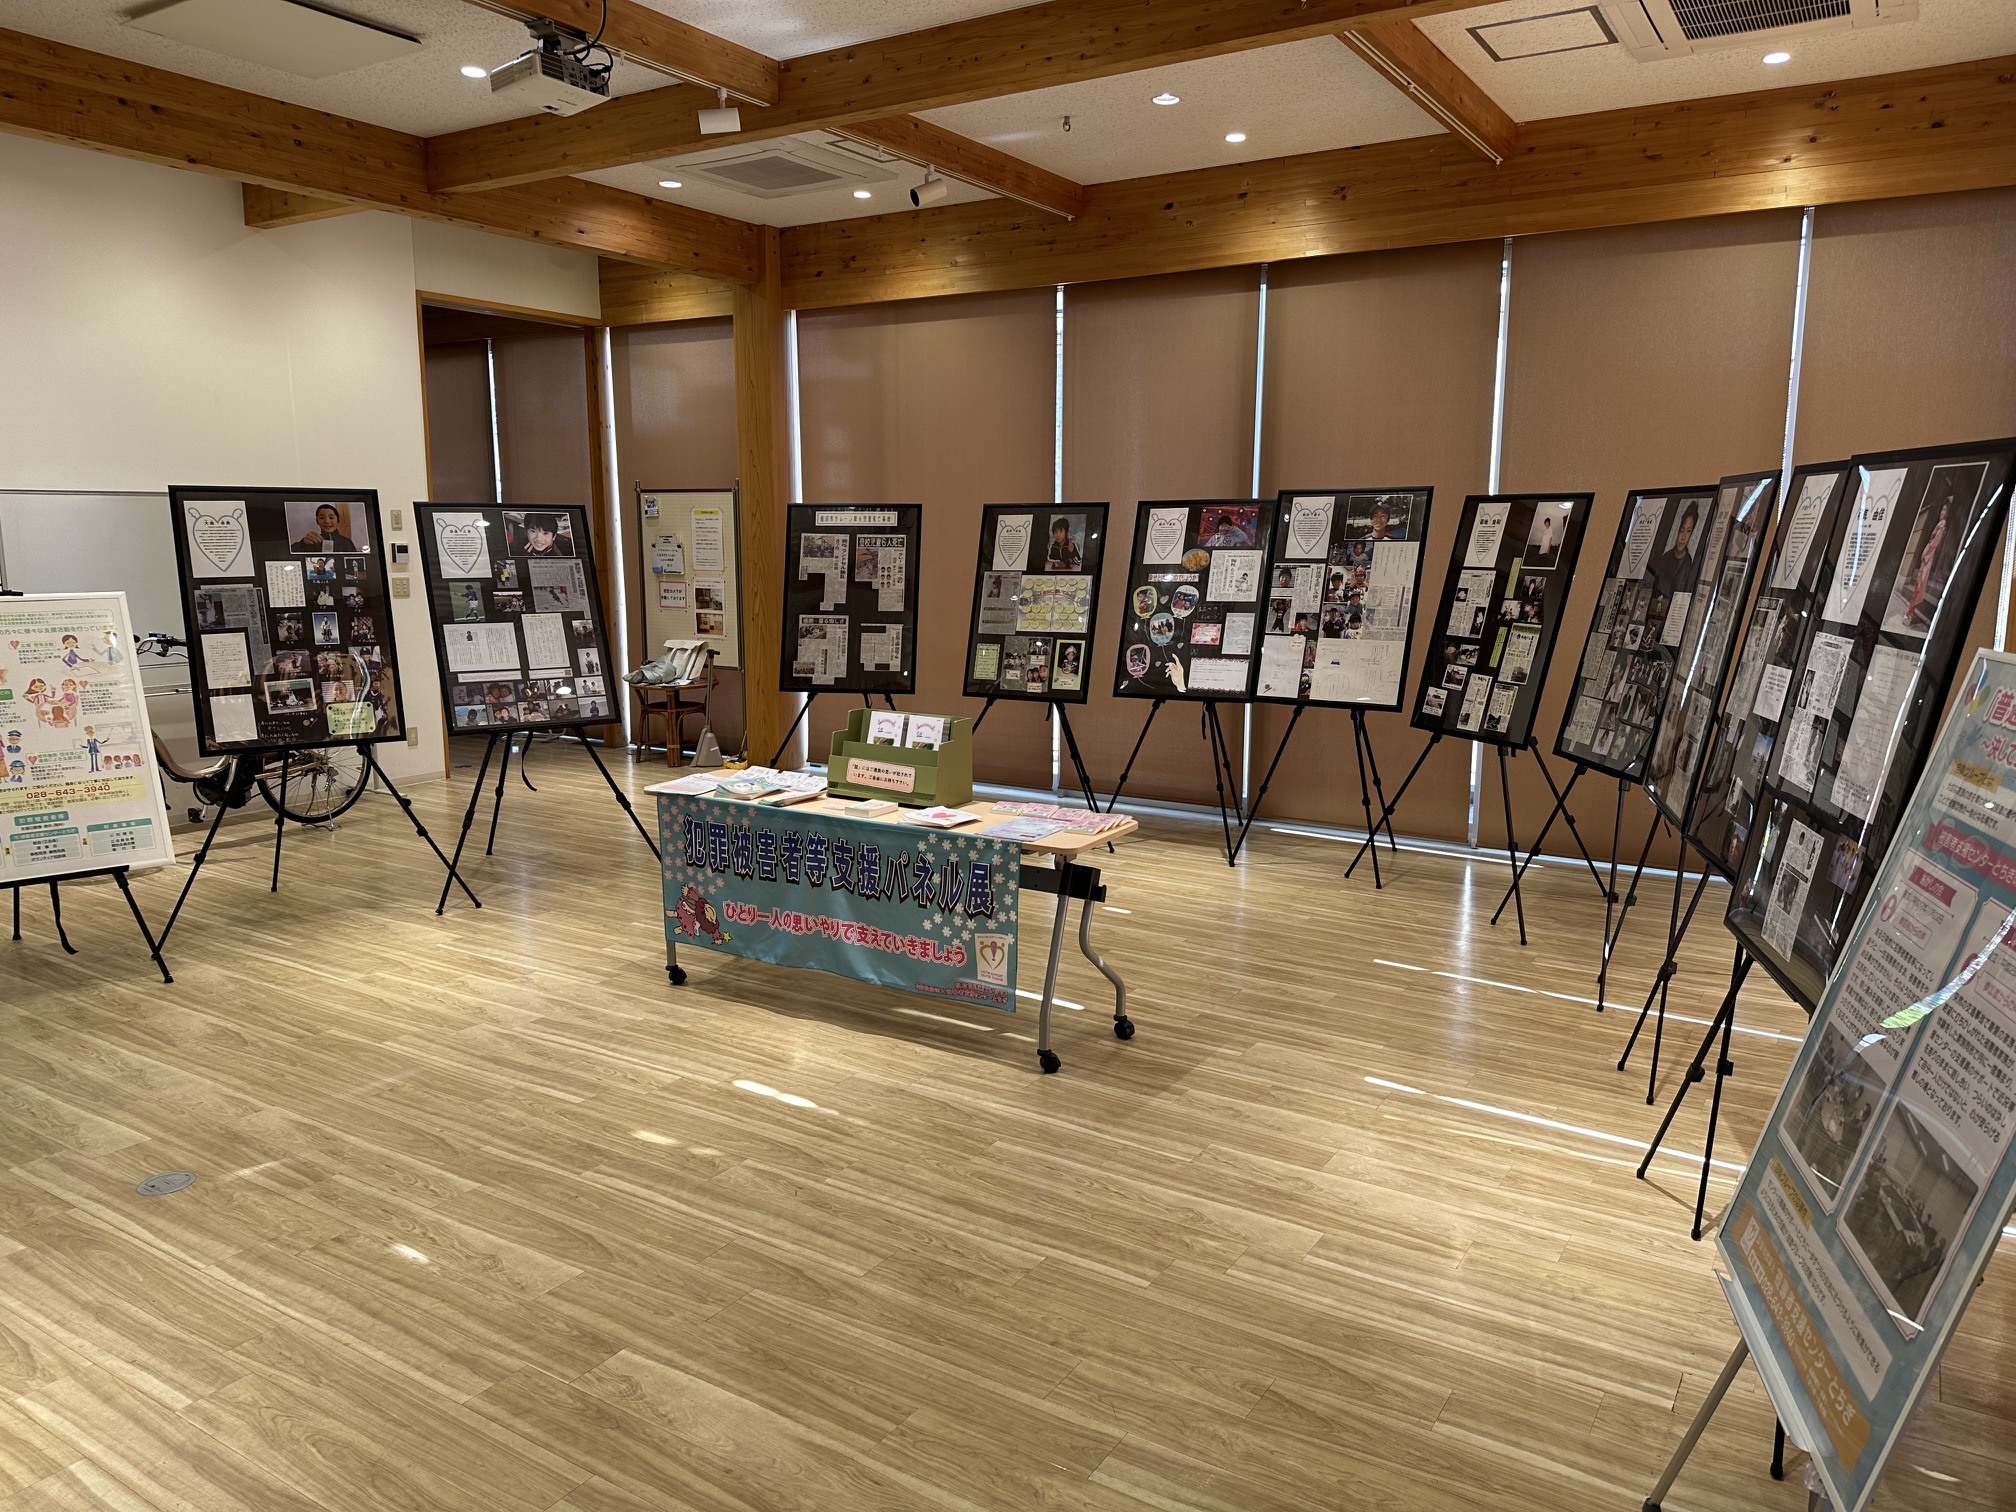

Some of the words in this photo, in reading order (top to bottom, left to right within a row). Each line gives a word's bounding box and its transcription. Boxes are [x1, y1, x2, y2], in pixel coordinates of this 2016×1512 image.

[683, 814, 998, 921] 犯罪被害者等支援パネル展
[1938, 830, 2016, 888] 被害者支援センターとちぎ
[722, 900, 968, 967] ひとり一人の思いやりで支えていきましょう
[1936, 1016, 2016, 1091] 体験をした家族同志で月に一度集まり、
[1917, 1056, 2002, 1144] て自分一人だけではないと、心が安らげる
[1774, 1268, 1857, 1427] 被害者支援センターとちぎ
